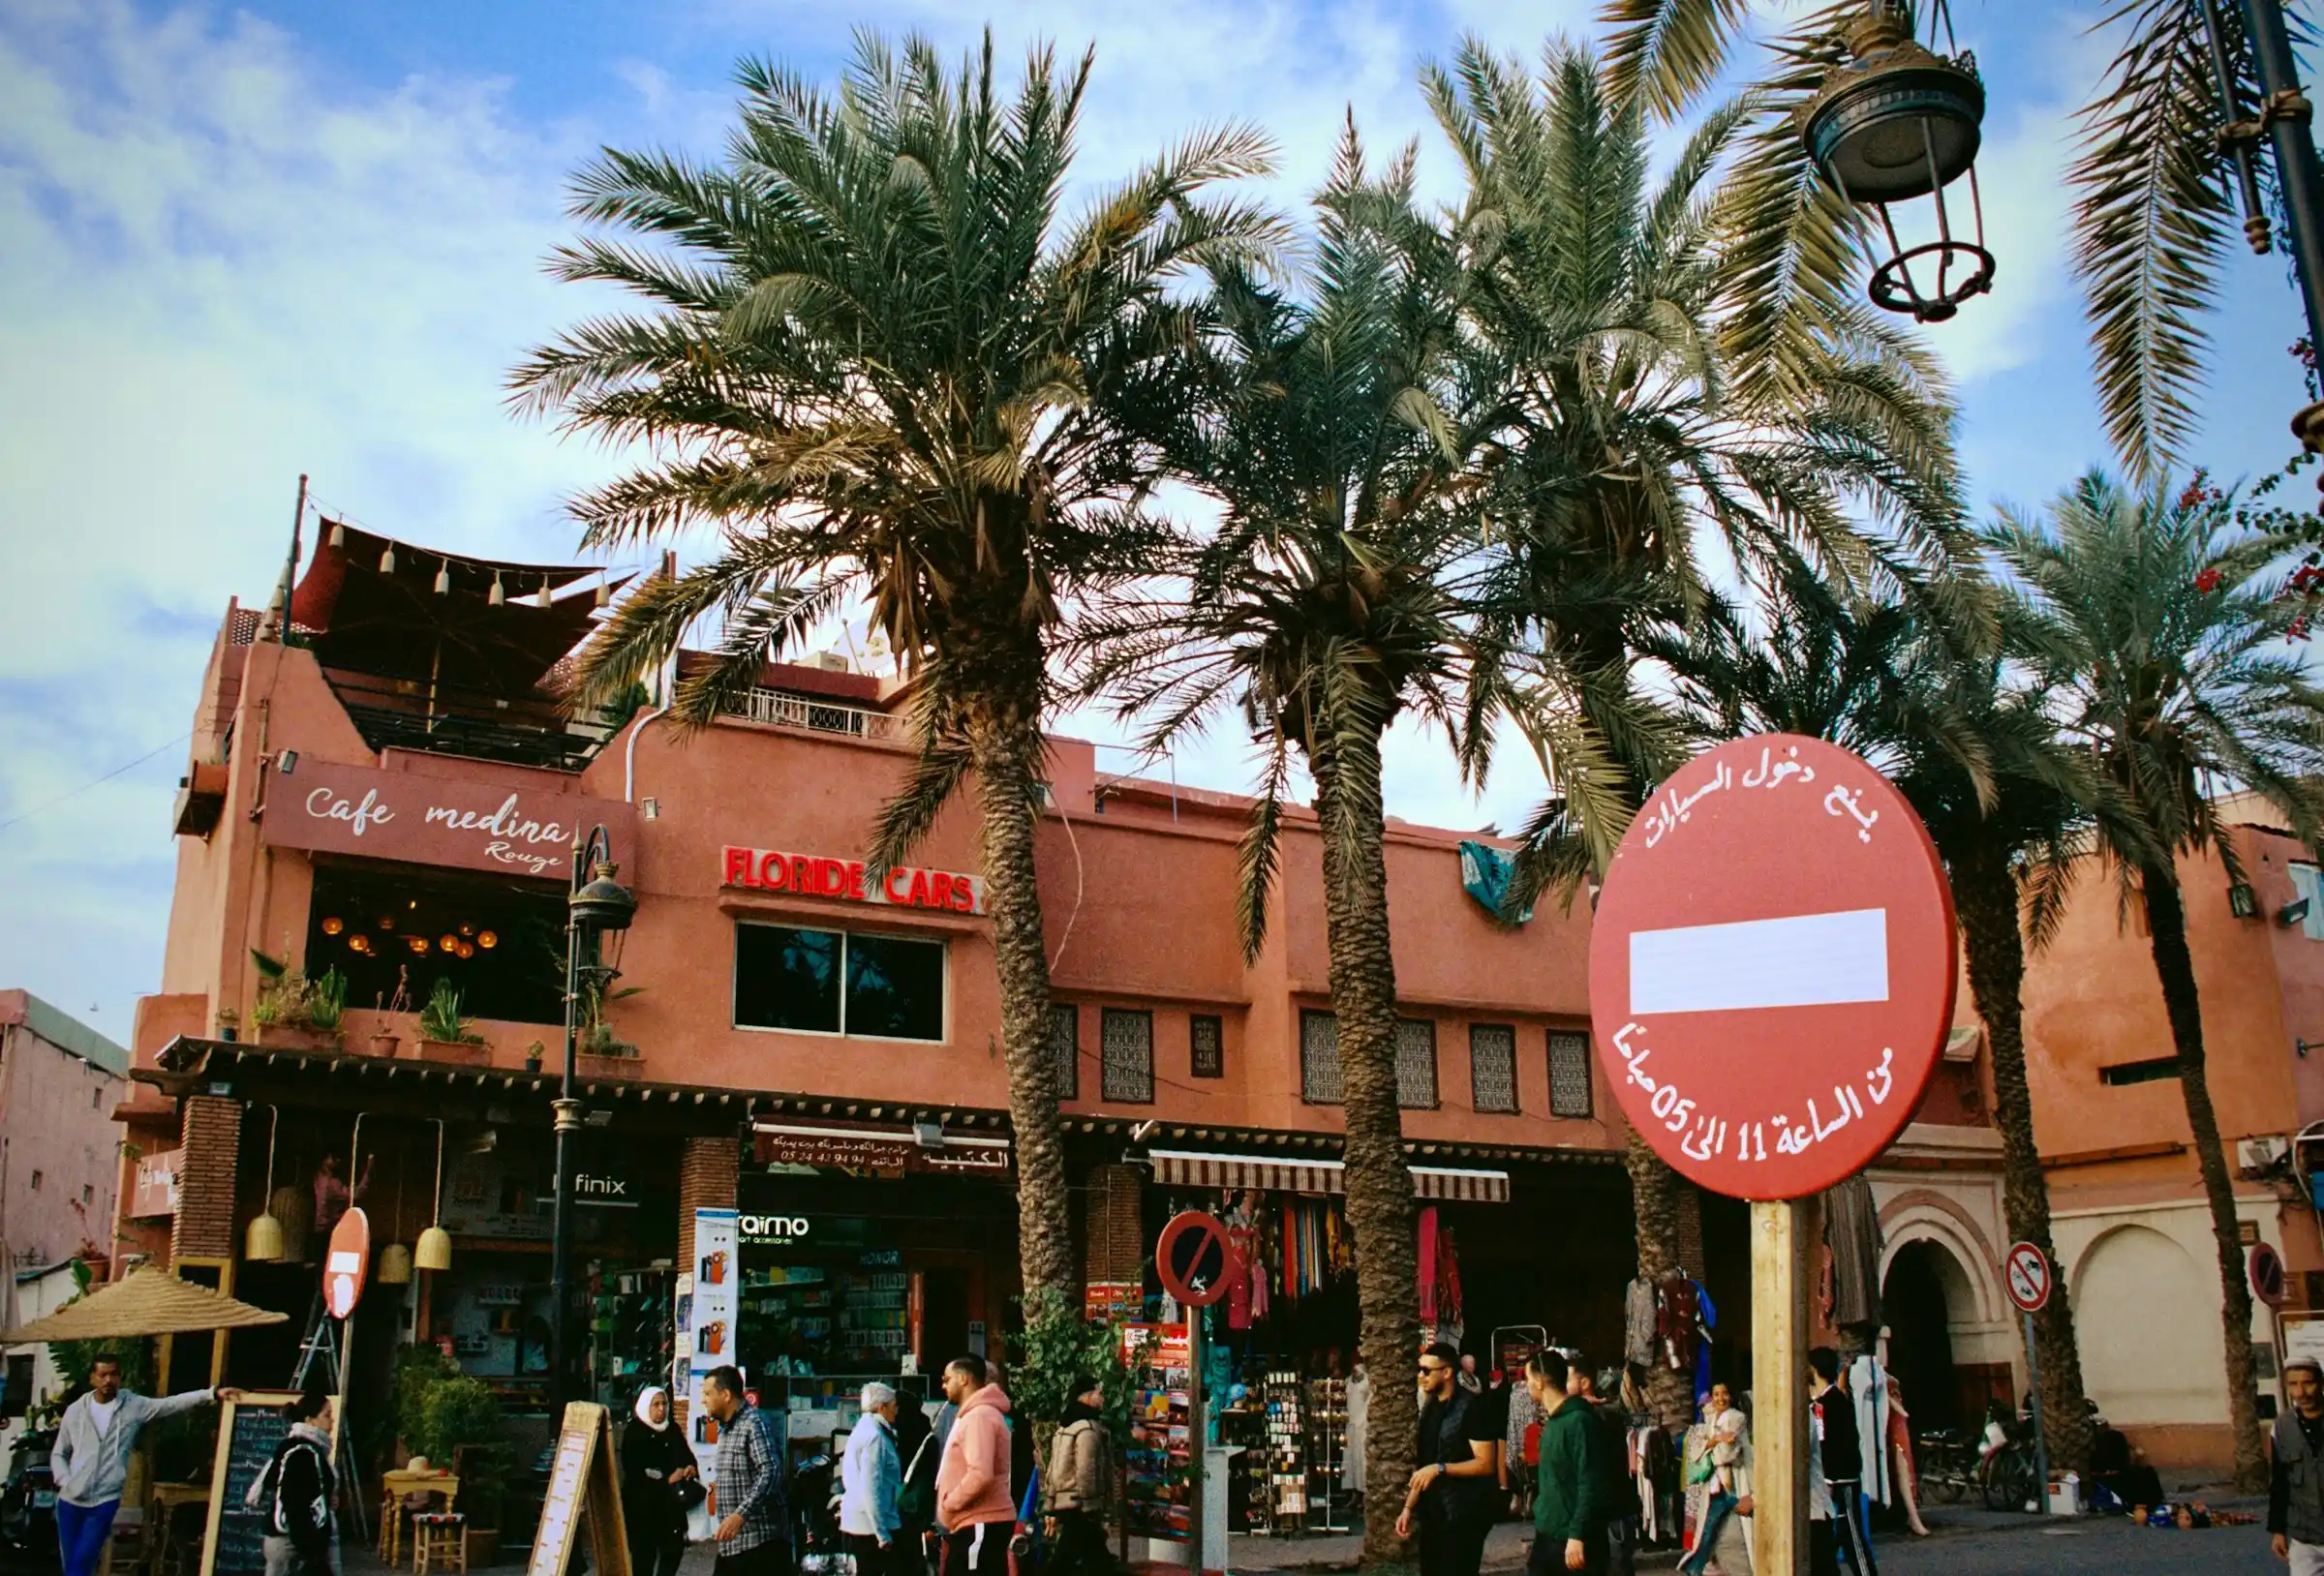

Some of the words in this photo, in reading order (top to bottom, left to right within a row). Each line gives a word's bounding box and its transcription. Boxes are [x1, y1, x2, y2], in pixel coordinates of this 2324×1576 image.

[1742, 745, 1816, 788] دخول
[306, 787, 396, 836] Cafe
[425, 793, 569, 844] medina
[1645, 760, 1731, 848] السيارات
[484, 840, 563, 873] Rouge
[725, 847, 866, 899] FLORIDE
[883, 865, 976, 912] CARS
[1867, 1046, 1893, 1105] من
[1650, 1084, 1697, 1132] 05
[1771, 1084, 1863, 1155] الساعة
[780, 1150, 796, 1161] 05
[798, 1151, 813, 1162] 24
[834, 1153, 849, 1165] 94
[851, 1154, 866, 1166] 94
[1737, 1122, 1767, 1161] 11
[552, 1173, 627, 1195] Ifinix
[859, 1250, 900, 1266] HONOR
